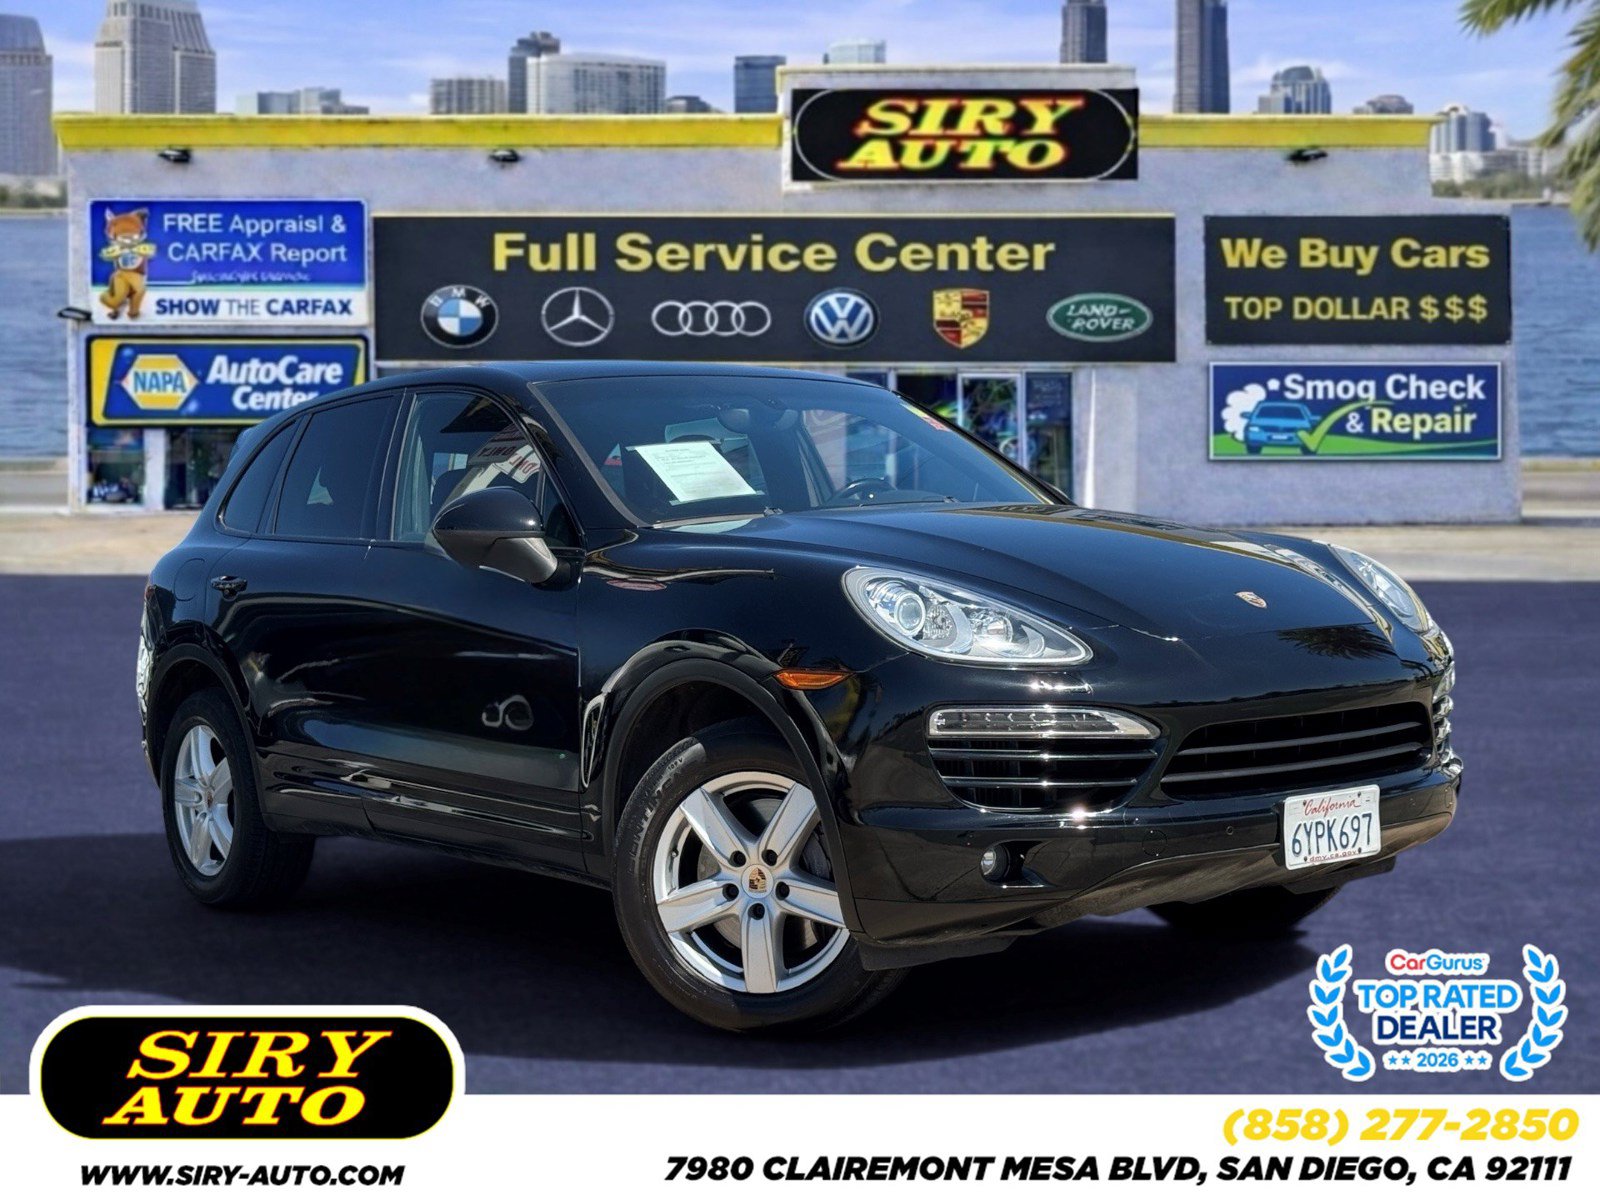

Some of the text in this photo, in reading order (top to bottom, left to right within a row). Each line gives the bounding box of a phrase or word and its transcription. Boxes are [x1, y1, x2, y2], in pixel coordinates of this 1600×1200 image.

[853, 97, 1085, 137] SIRY
[836, 138, 1066, 170] AUTO
[163, 213, 223, 233] FREE
[331, 215, 347, 233] &
[167, 243, 262, 262] CARFAX
[270, 243, 348, 267] Report
[493, 231, 1056, 273] Full Service Center
[1220, 238, 1491, 276] We Buy Cars
[155, 299, 353, 315] SHOW THE CARFAX
[1224, 297, 1283, 320] TOP
[1292, 297, 1411, 320] DOLLAR
[131, 371, 187, 392] NAPA
[206, 356, 343, 385] AutoCare
[1385, 374, 1486, 400] Check
[1344, 405, 1477, 440] & Repair
[1304, 797, 1361, 817] California
[1292, 812, 1372, 855] 6YPK697
